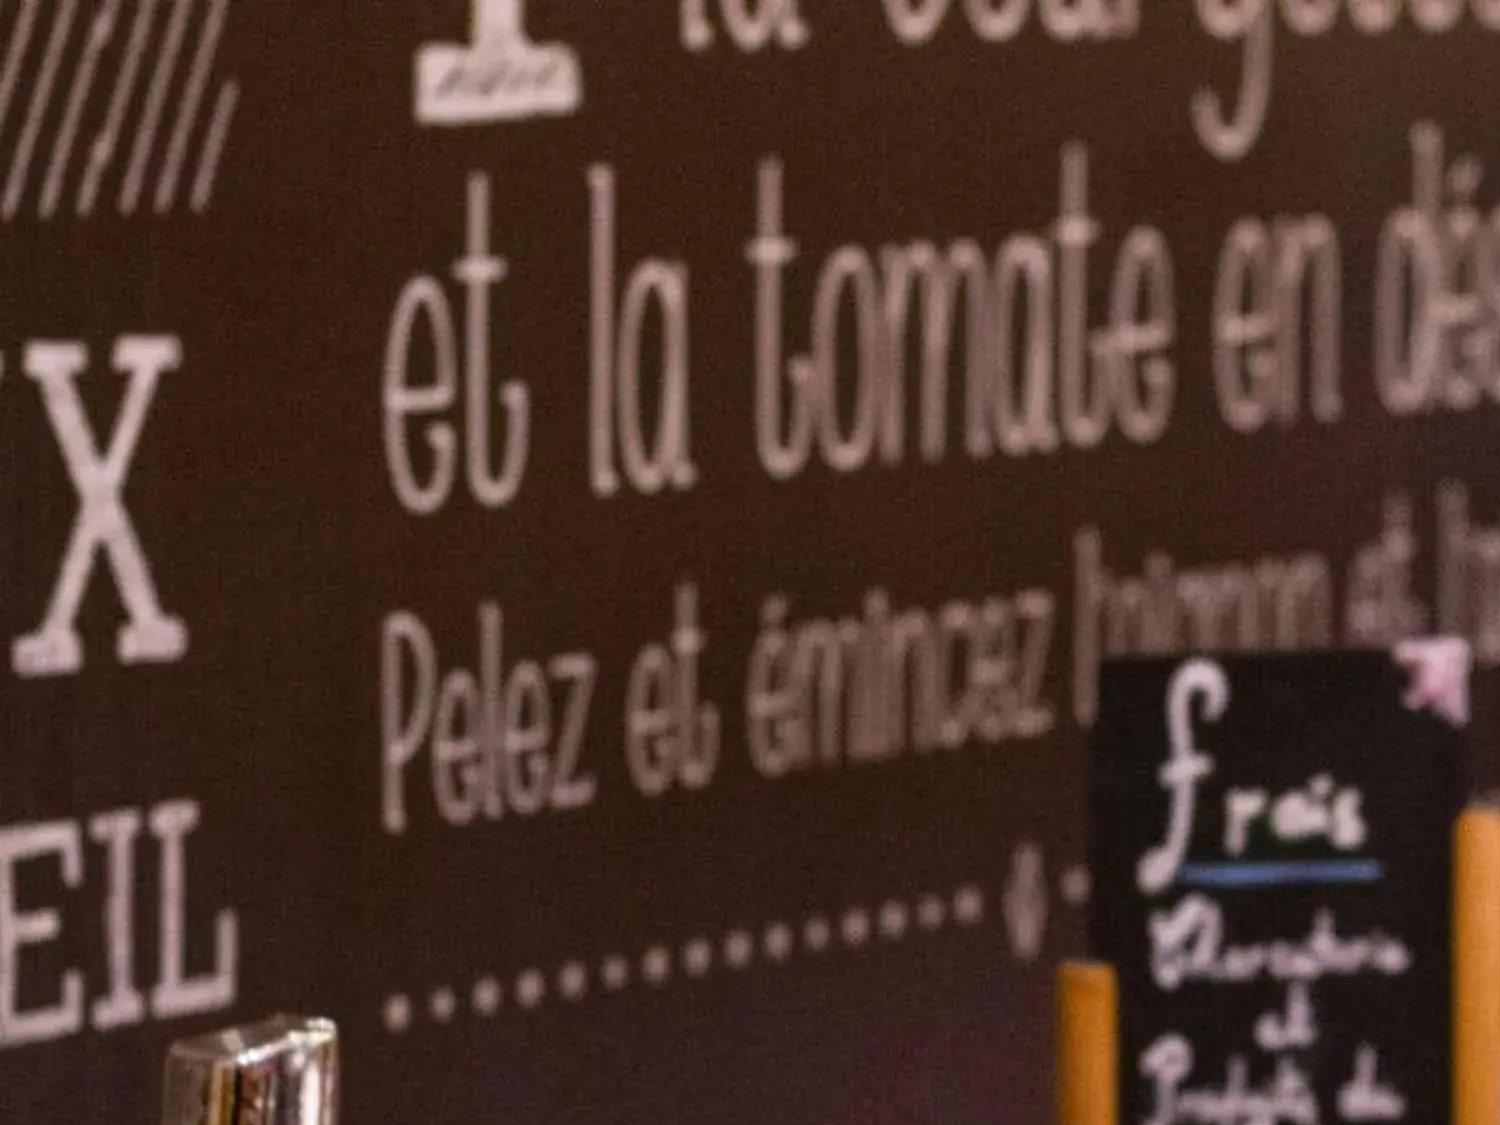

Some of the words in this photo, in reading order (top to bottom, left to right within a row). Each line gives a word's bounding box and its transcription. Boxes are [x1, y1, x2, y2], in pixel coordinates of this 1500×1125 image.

[382, 171, 530, 514] et
[587, 162, 697, 495] la
[744, 142, 1174, 478] tomate
[1212, 214, 1342, 430] en
[380, 601, 597, 834] Pelez
[625, 582, 722, 795] et
[745, 585, 1056, 778] émincez
